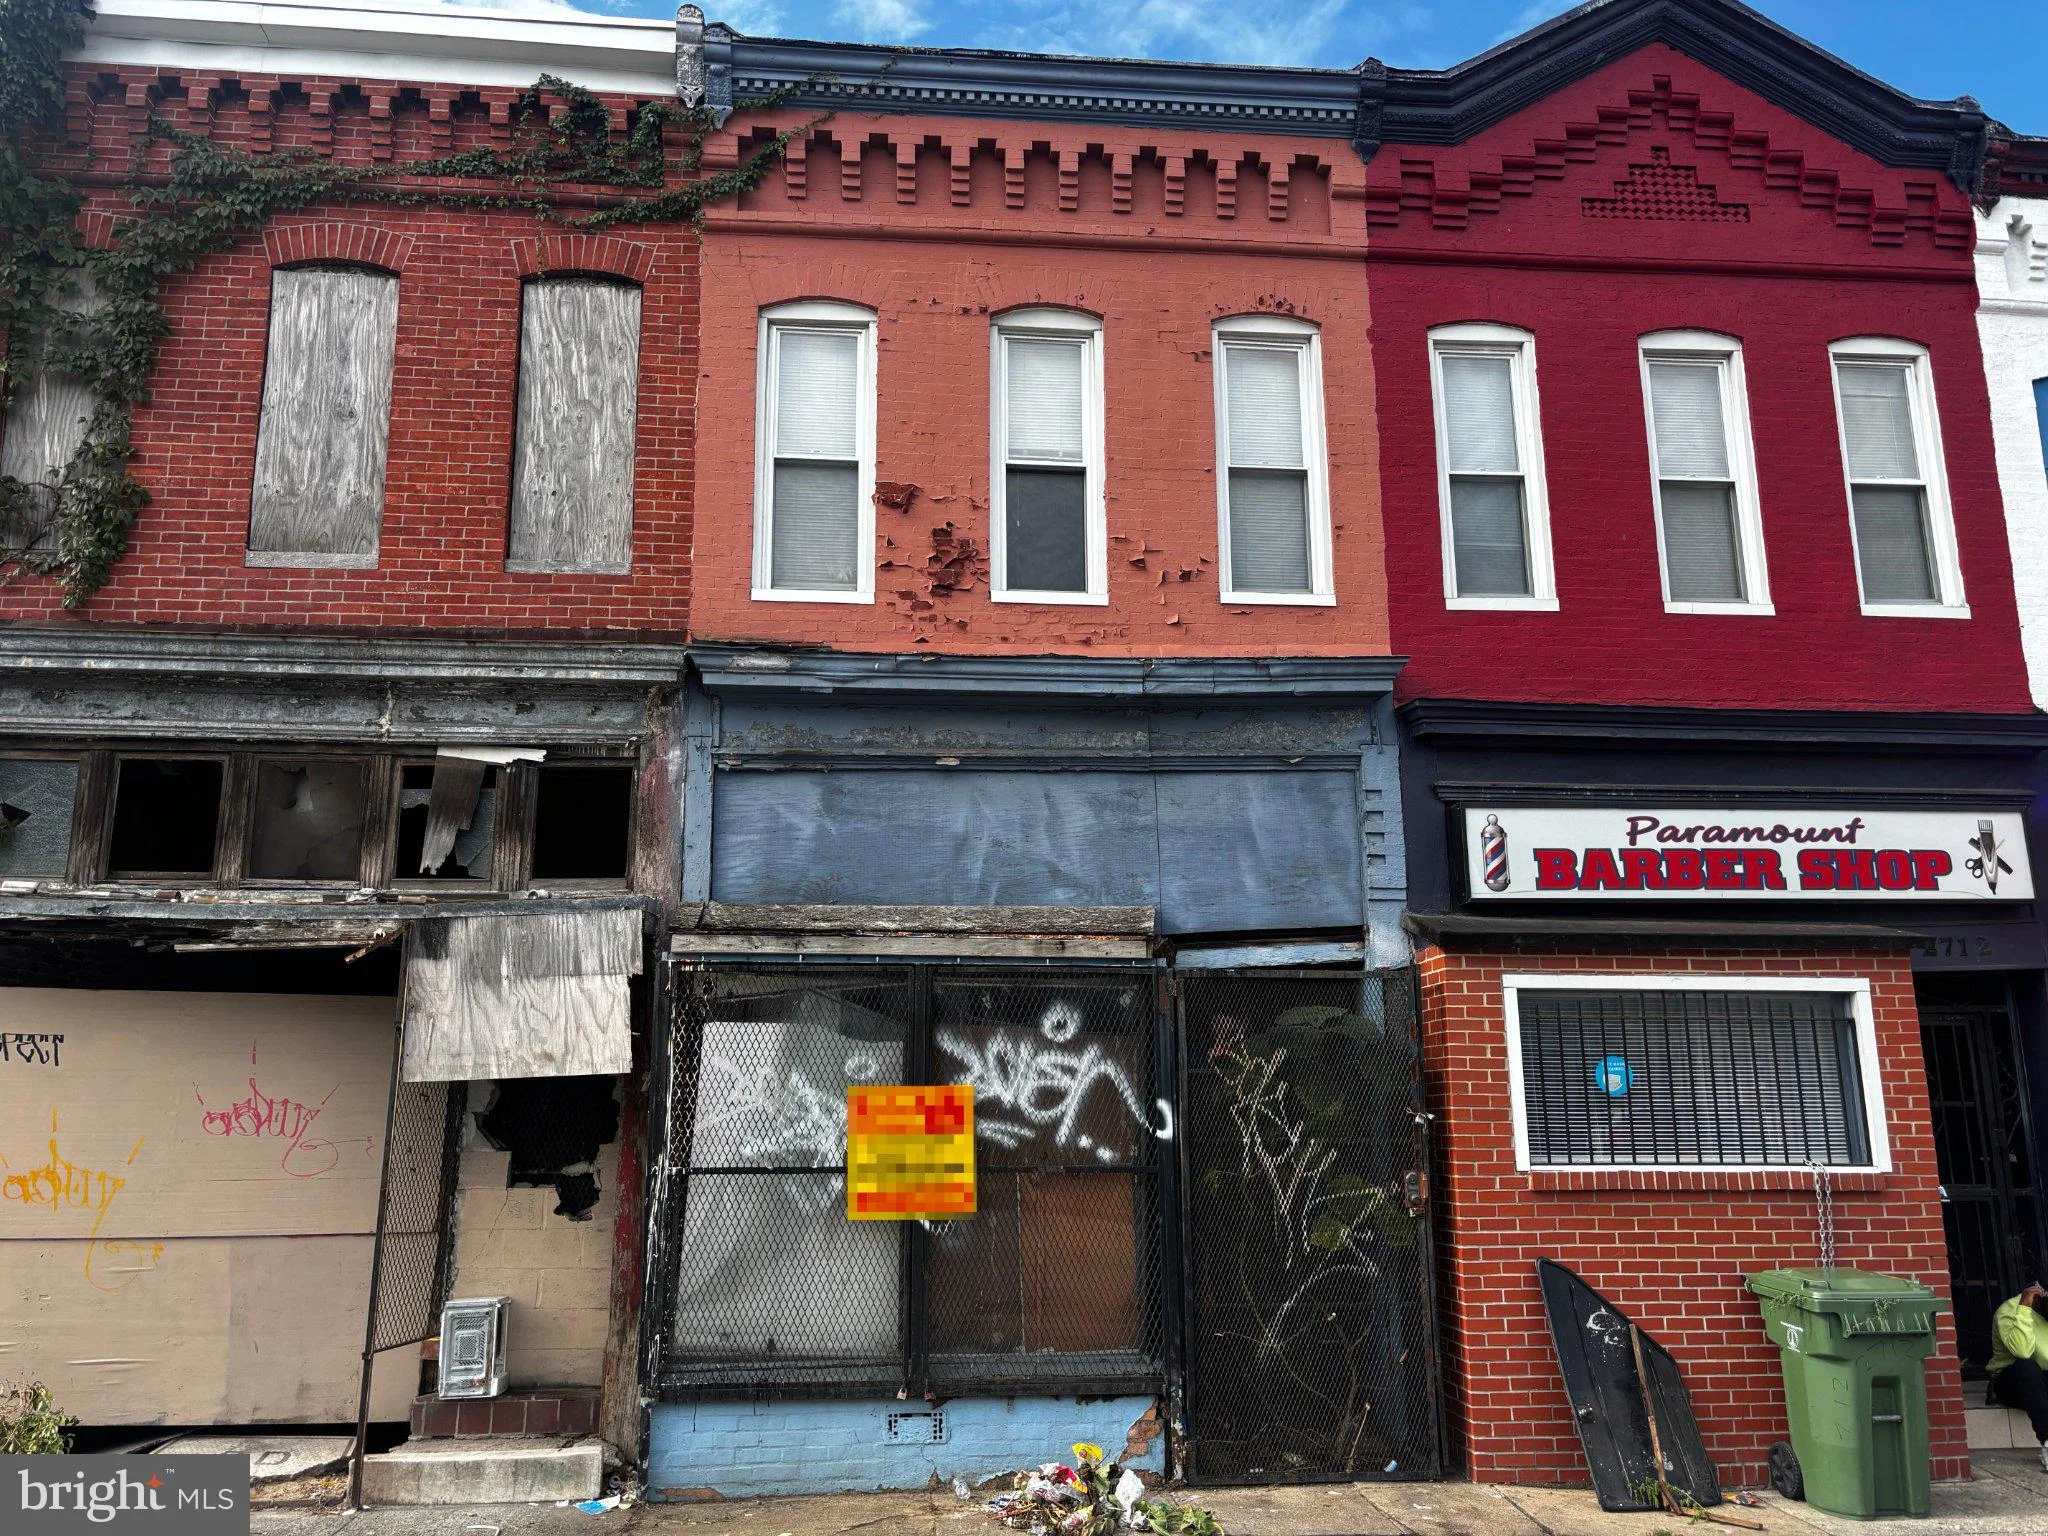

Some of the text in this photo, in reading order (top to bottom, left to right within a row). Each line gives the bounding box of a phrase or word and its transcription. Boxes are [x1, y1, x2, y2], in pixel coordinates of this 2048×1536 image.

[1626, 815, 1866, 847] Paramount
[1534, 847, 1953, 892] BARBER SHOP
